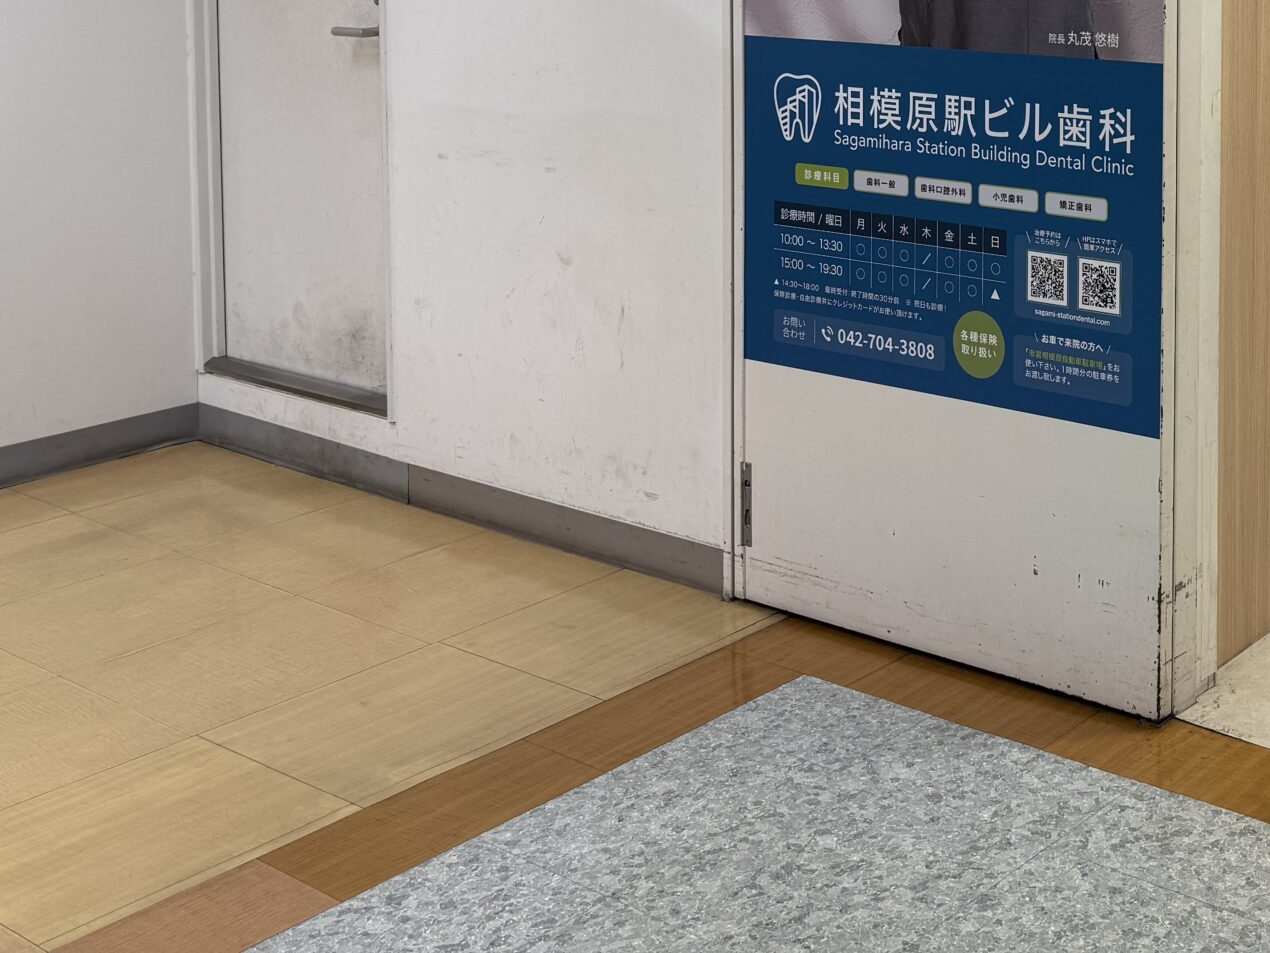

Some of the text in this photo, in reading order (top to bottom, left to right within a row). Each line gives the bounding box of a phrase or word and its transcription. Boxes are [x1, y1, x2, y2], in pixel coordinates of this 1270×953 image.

[1048, 33, 1065, 44] 院長
[1067, 30, 1092, 46] 丸茂
[834, 84, 1135, 154] 相模原駅ビル歯科
[834, 130, 1134, 176] Sagamihara Station Building Dental Clinic
[804, 169, 840, 184] 診療科目
[866, 177, 896, 189] 歯科一般
[920, 183, 966, 197] 歯科口腔外科
[992, 192, 1023, 204] 小児歯科
[1059, 200, 1092, 213] 矯正歯科
[856, 218, 865, 230] 月
[877, 221, 887, 233] 火
[900, 223, 909, 236] 水
[921, 226, 931, 238] 木
[944, 229, 954, 242] 金
[967, 233, 977, 246] 土
[991, 235, 999, 248] 日
[782, 316, 806, 328] お問い
[1034, 309, 1110, 326] sagami-stationdental.com
[782, 328, 806, 340] 合わせ
[960, 330, 998, 346] 各種保険
[837, 328, 935, 360] 042-704-3808
[961, 343, 997, 358] 取り扱い
[1041, 334, 1104, 353] お車で来院の方へ
